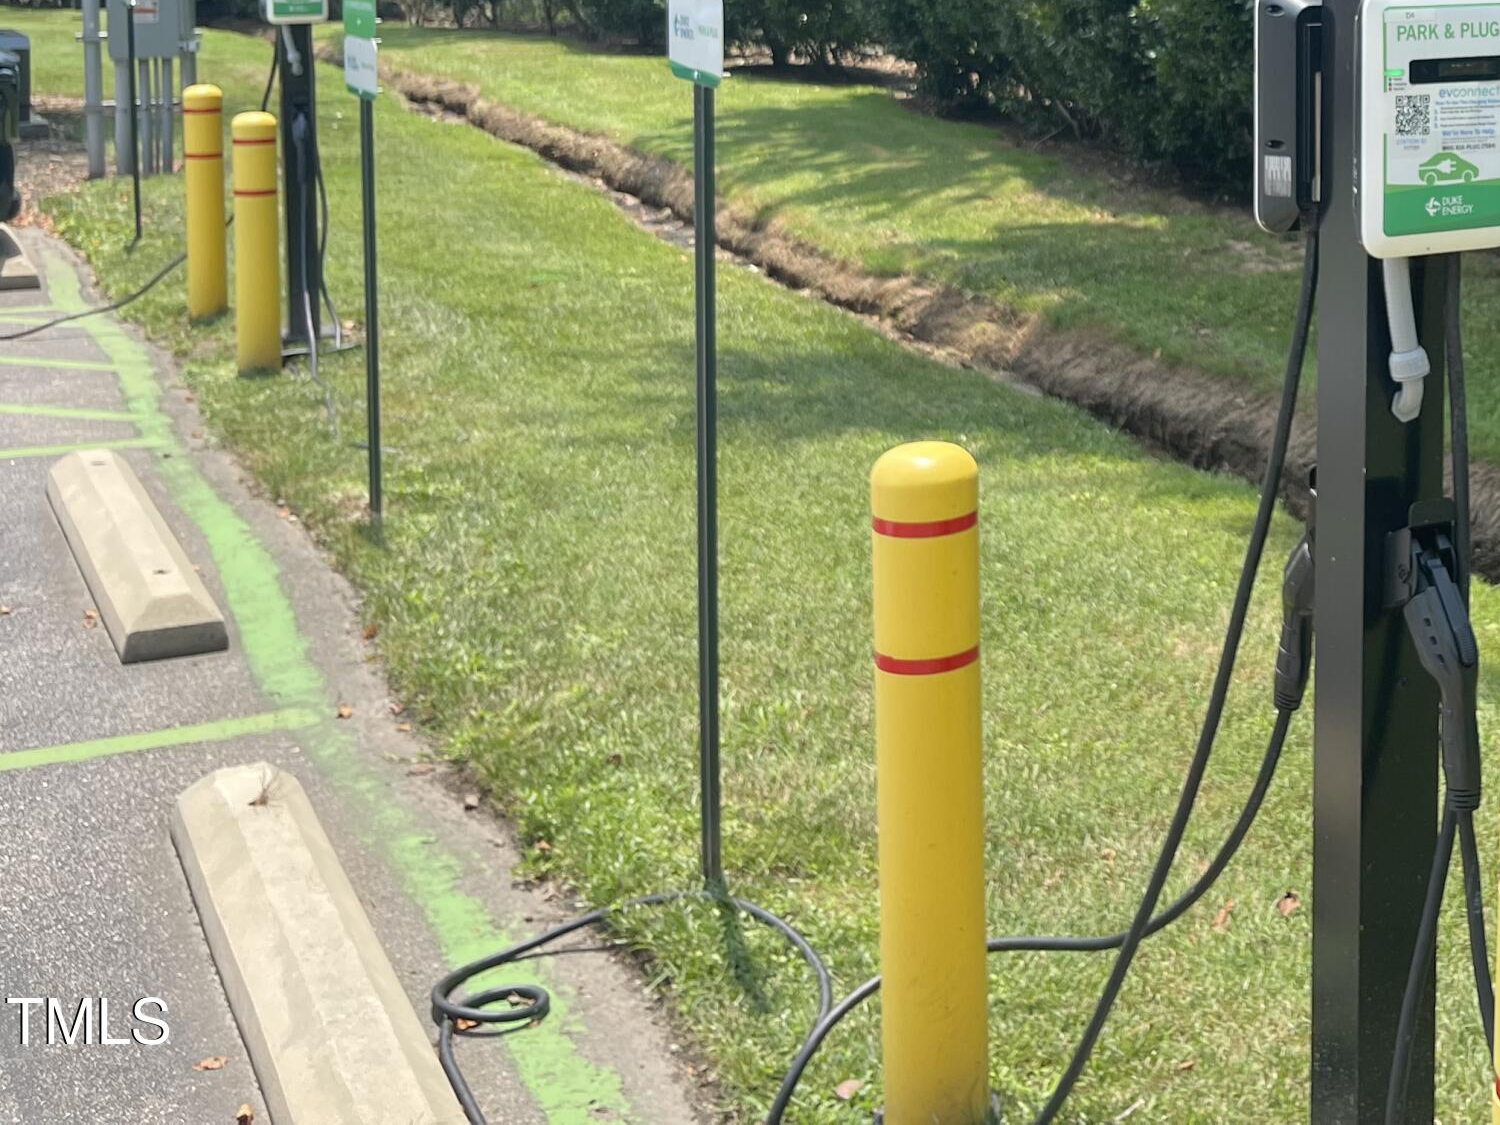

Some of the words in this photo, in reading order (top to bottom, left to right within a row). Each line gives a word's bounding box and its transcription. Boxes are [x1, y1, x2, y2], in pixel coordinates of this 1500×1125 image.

[1396, 23, 1439, 42] PARK
[1444, 23, 1455, 40] &
[1460, 21, 1500, 39] PLUG
[1439, 86, 1500, 98] evconnect
[1442, 195, 1463, 206] DUKE
[1442, 204, 1474, 216] ENERGY
